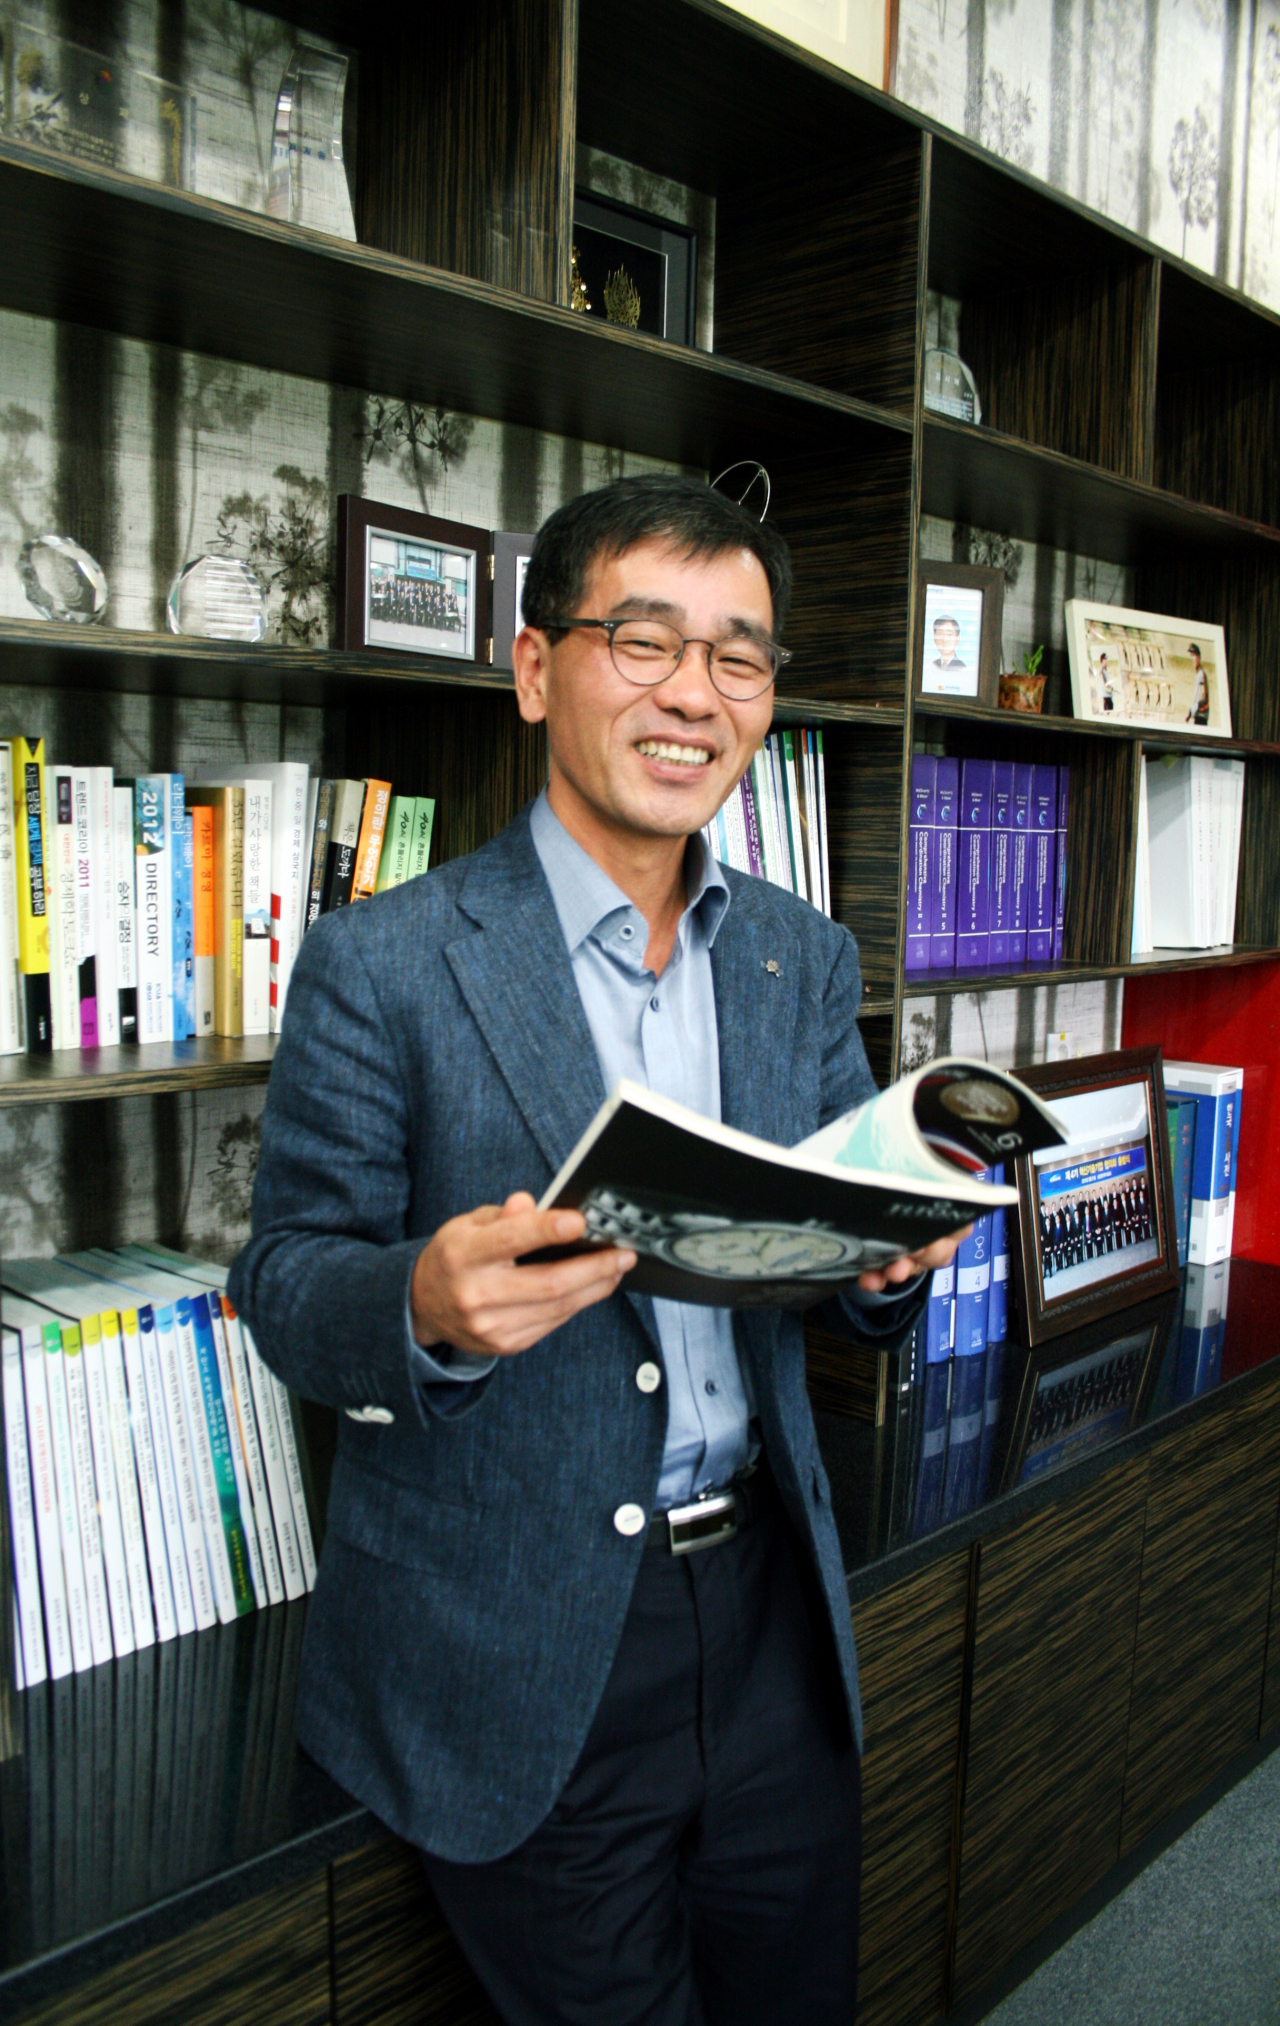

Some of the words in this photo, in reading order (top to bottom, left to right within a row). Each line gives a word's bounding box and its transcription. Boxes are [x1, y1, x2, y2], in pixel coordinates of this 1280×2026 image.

[25, 765, 37, 788] 지금
[28, 790, 41, 814] 당장
[75, 780, 87, 815] 트렌드
[249, 795, 262, 824] 내가
[371, 789, 389, 831] 정의란
[142, 792, 159, 844] 2012
[342, 821, 356, 844] 책은
[76, 818, 88, 853] 코리아
[201, 821, 212, 860] 카르마
[249, 827, 262, 871] 사랑한
[78, 859, 90, 888] 2011
[337, 846, 351, 878] 도끼다
[30, 866, 46, 915] 공부하라
[201, 870, 212, 892] 경영
[248, 875, 261, 904] 책들
[145, 863, 158, 957] DIRECTORY
[944, 1277, 949, 1289] 3
[974, 1276, 980, 1287] 4
